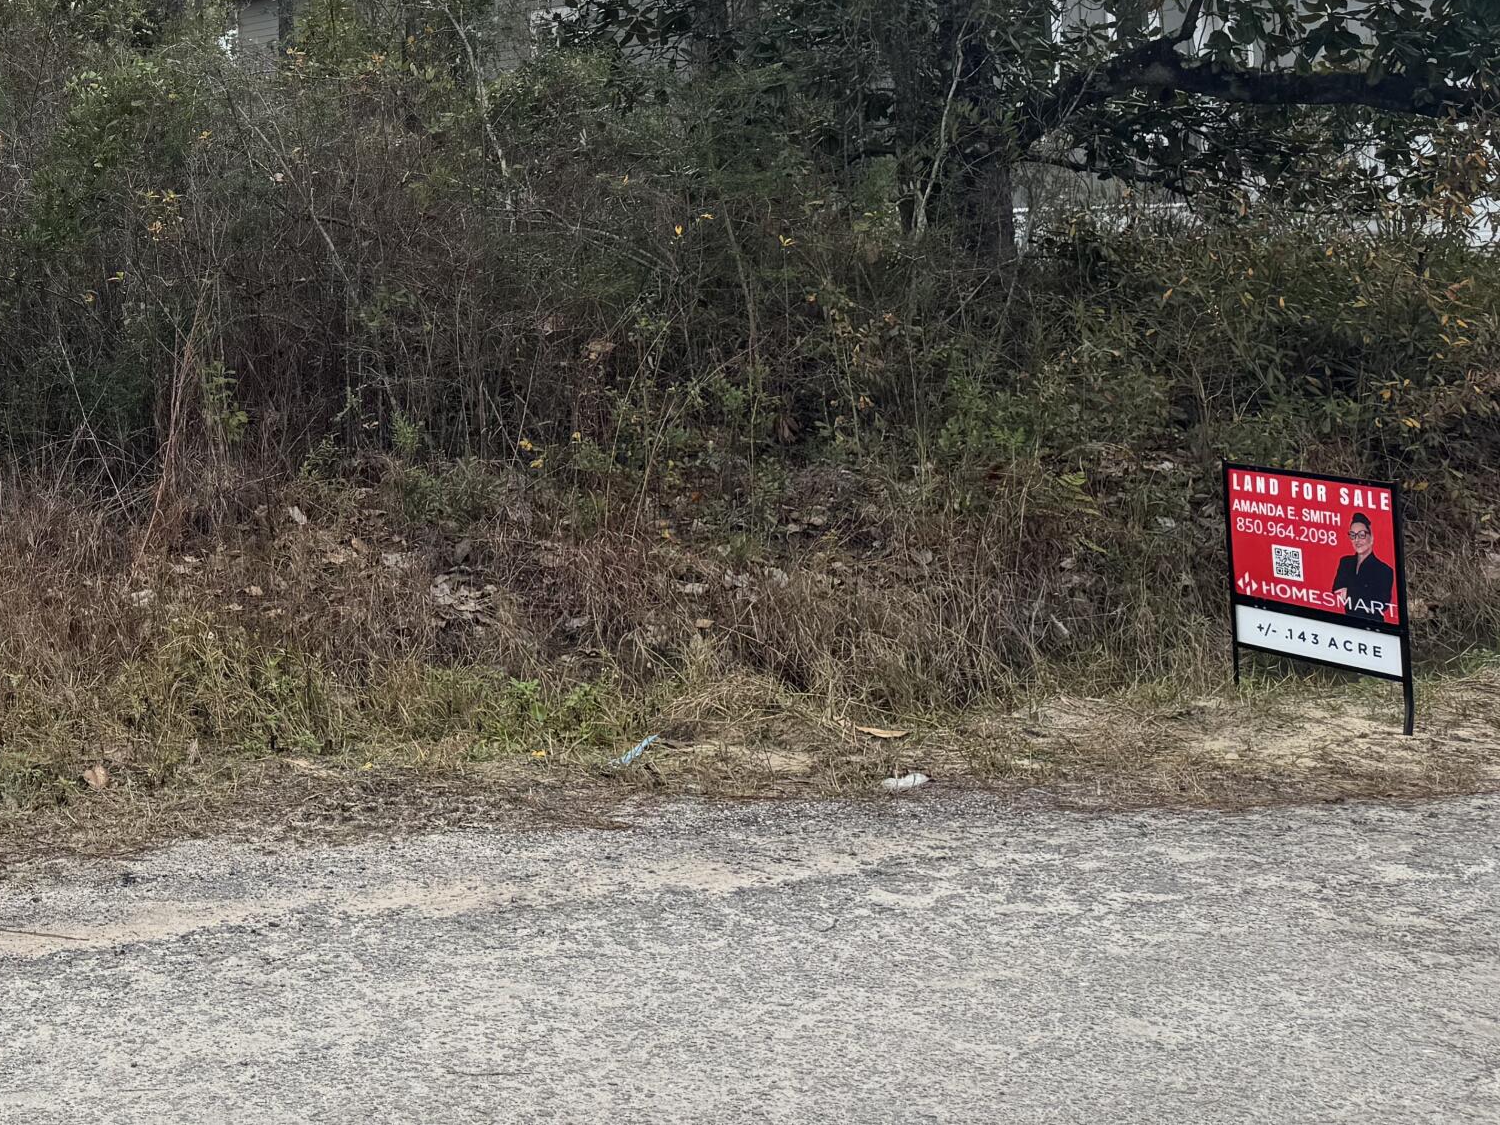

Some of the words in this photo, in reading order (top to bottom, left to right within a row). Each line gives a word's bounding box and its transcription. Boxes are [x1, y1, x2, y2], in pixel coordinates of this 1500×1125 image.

[1232, 473, 1279, 496] LAND
[1291, 480, 1327, 503] FOR
[1339, 487, 1390, 511] SALE
[1232, 498, 1285, 519] AMANDA
[1287, 506, 1299, 521] E.
[1301, 508, 1341, 526] SMITH
[1236, 516, 1338, 546] 850.964.2098
[1261, 580, 1398, 618] HOMESMART
[1256, 623, 1277, 637] +/-
[1285, 628, 1320, 645] .143
[1327, 637, 1383, 658] ACRE
